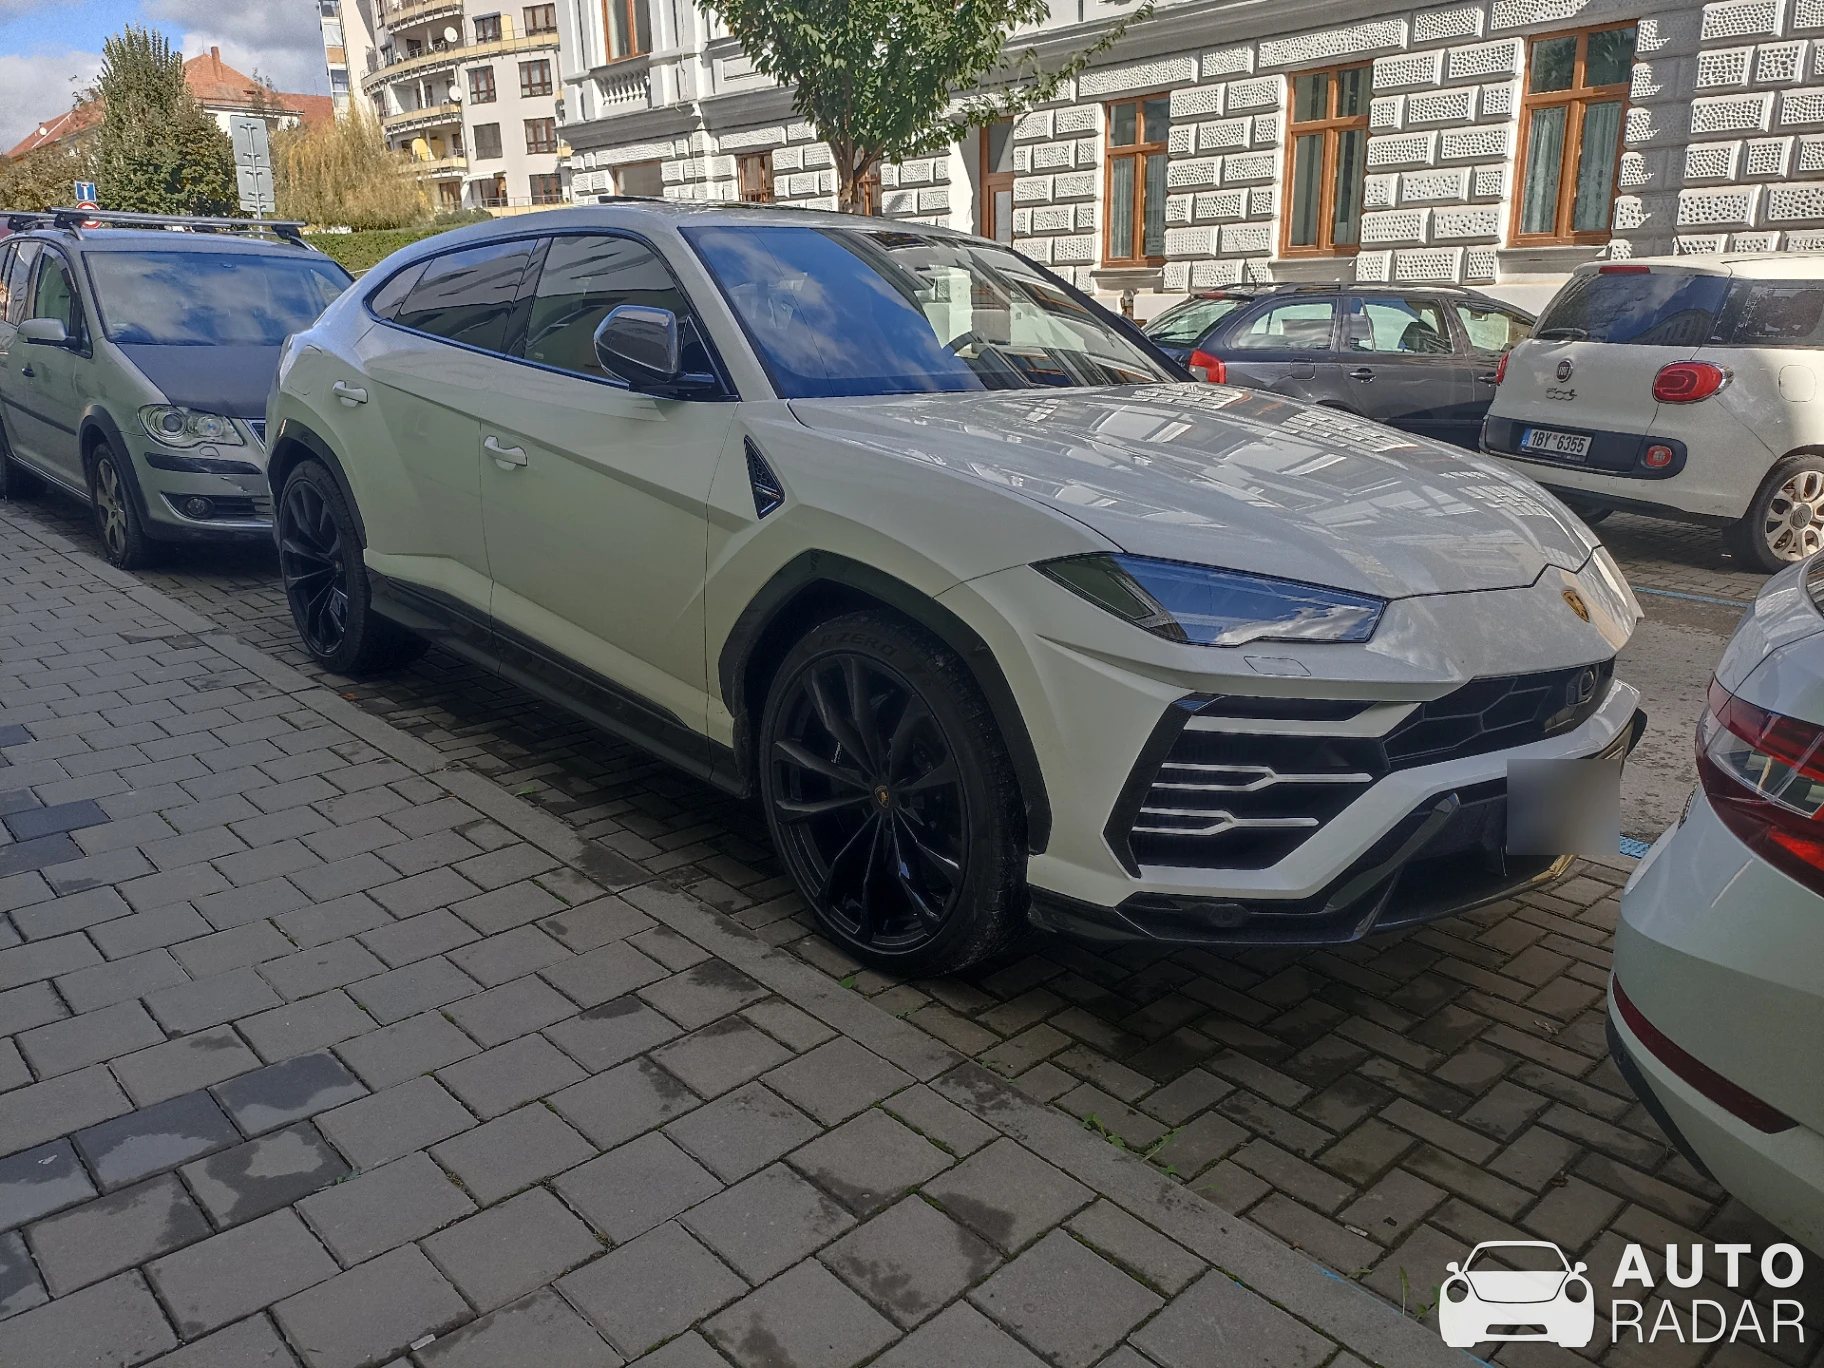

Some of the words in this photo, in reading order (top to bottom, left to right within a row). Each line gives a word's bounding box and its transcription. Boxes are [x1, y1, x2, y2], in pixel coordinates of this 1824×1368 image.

[1532, 431, 1552, 448] 1BY
[1557, 435, 1586, 453] 6355
[820, 635, 832, 647] P
[836, 632, 897, 657] ZERO
